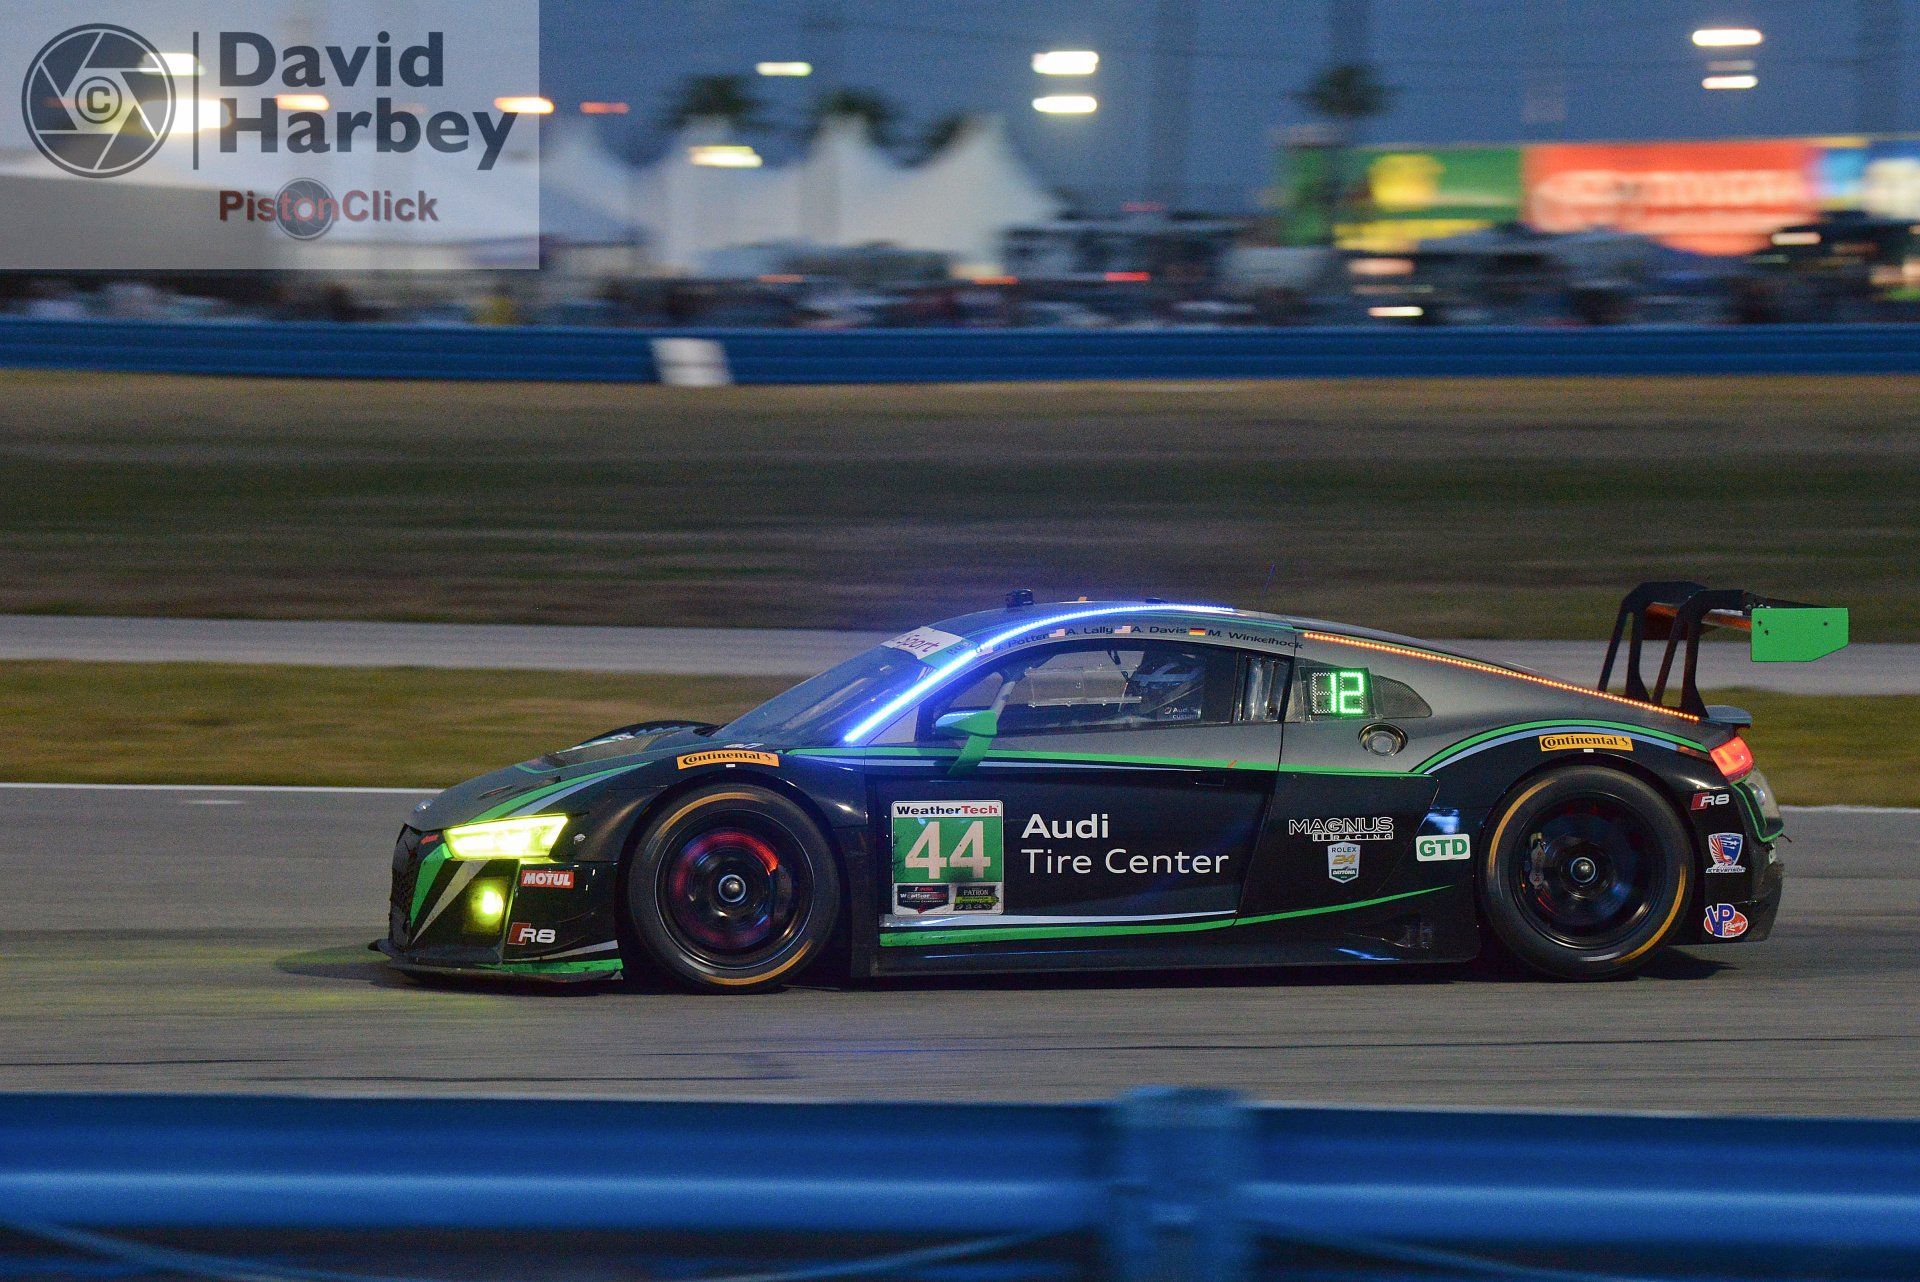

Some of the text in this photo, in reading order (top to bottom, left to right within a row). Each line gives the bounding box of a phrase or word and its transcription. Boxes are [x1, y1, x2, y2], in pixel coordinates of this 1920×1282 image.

[1065, 626, 1113, 636] A. Lally
[1149, 626, 1187, 634] Davis
[1208, 629, 1303, 650] M. Winkelhock
[1329, 671, 1364, 714] 12
[1541, 736, 1618, 749] Continental
[682, 751, 761, 765] Continental
[1700, 793, 1730, 808] R8
[896, 805, 998, 815] WeatherTech
[1021, 813, 1109, 839] Audi
[1288, 817, 1394, 835] MAGNUS
[904, 820, 991, 880] 44
[1419, 838, 1467, 857] GTD
[1021, 848, 1229, 874] Tire Center
[1332, 854, 1356, 865] 24
[523, 872, 571, 886] MOTUL
[1705, 903, 1736, 938] VP
[518, 927, 556, 944] R8
